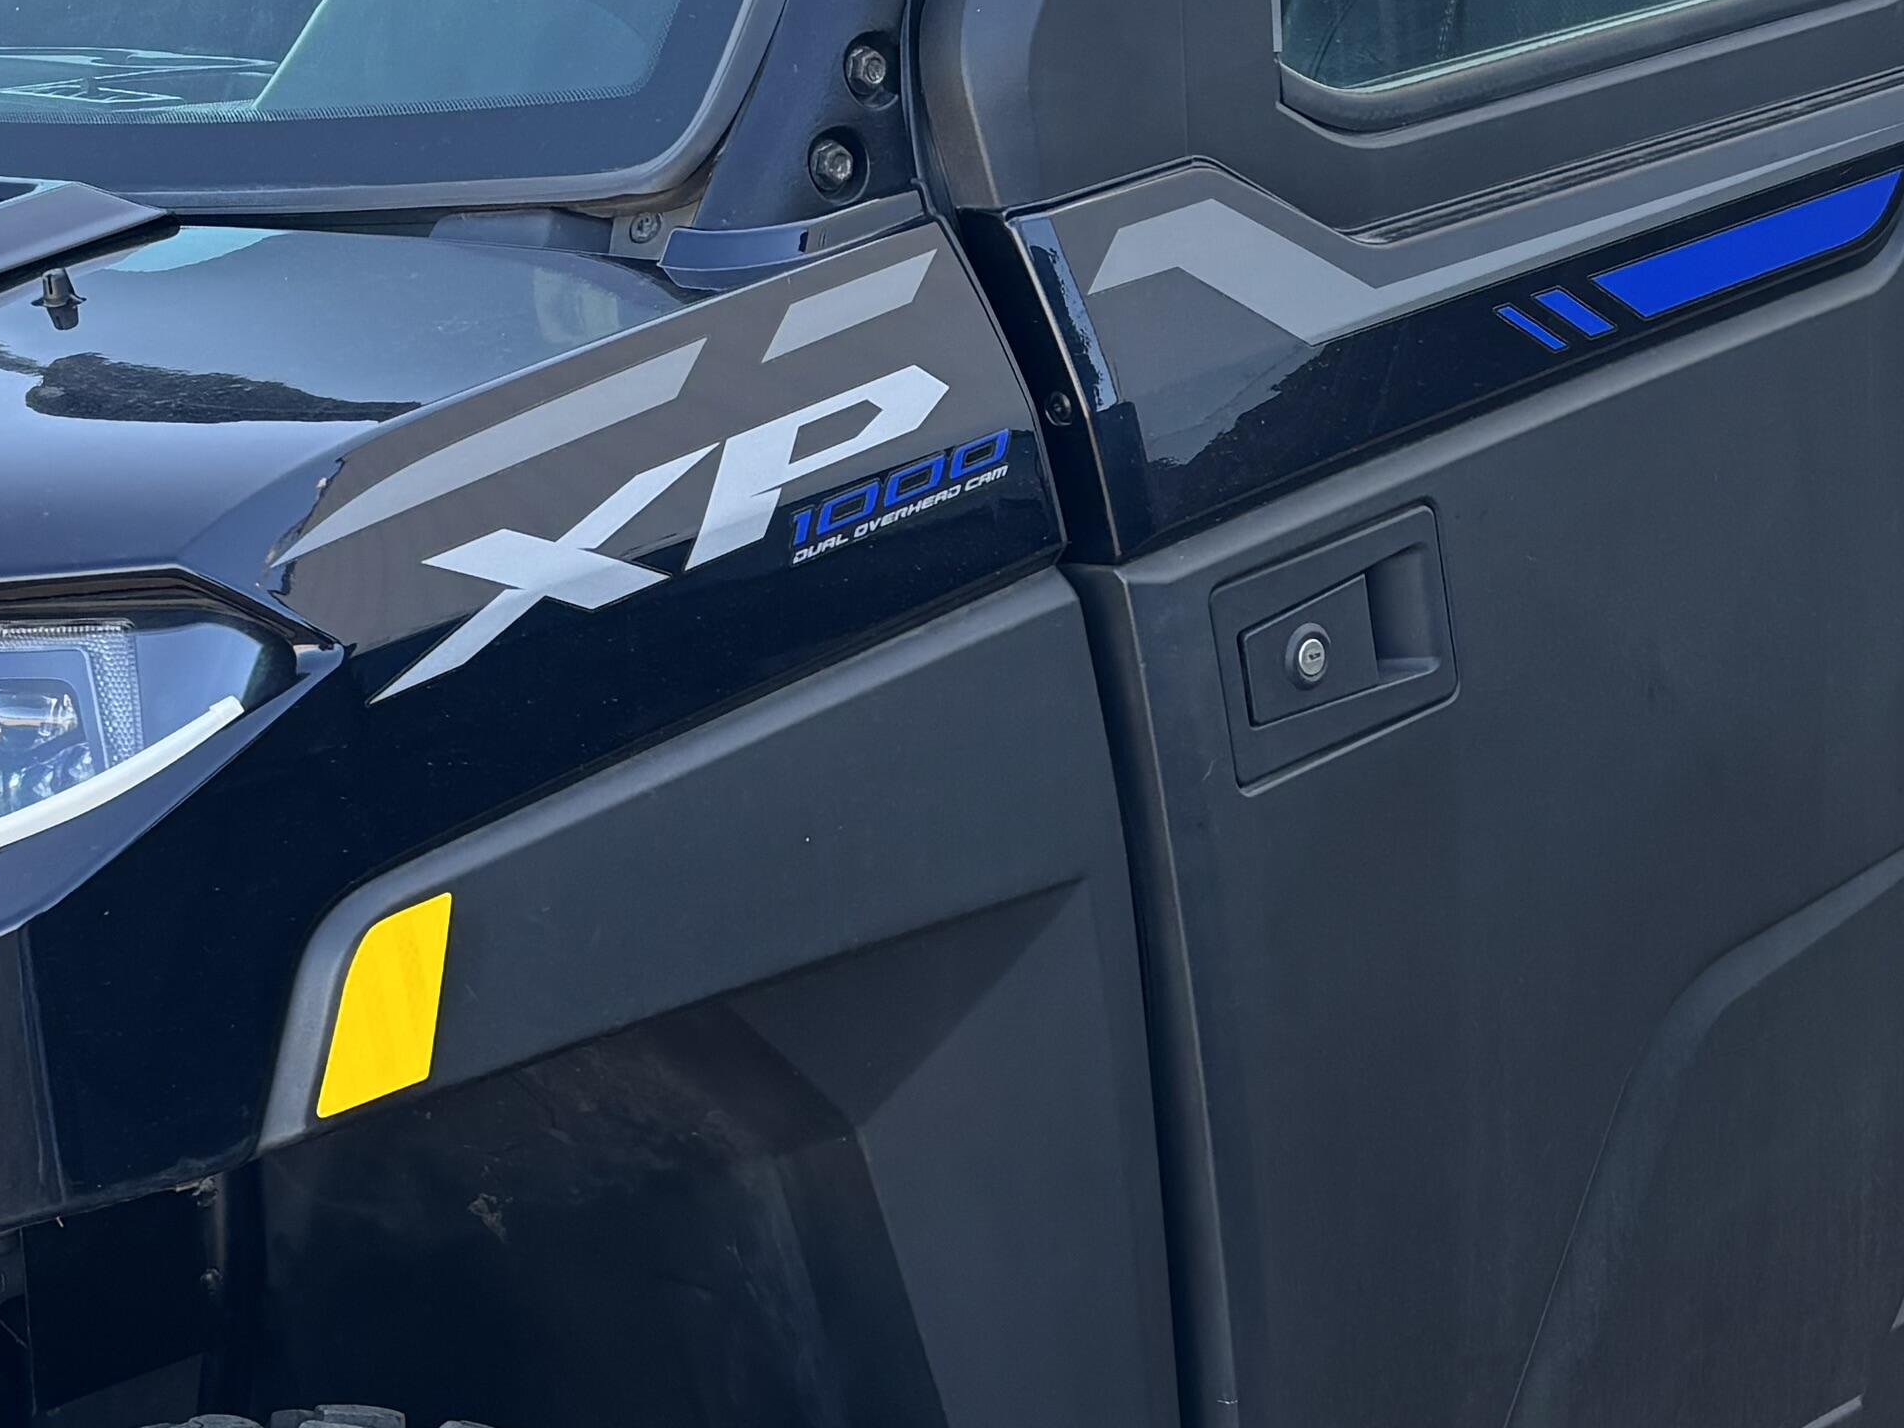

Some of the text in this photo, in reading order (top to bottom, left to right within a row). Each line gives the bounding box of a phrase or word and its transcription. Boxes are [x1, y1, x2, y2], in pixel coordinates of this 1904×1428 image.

[370, 364, 950, 704] XP
[793, 428, 1011, 547] 1000
[793, 464, 1009, 565] DUAL OVERHEAD CAM
